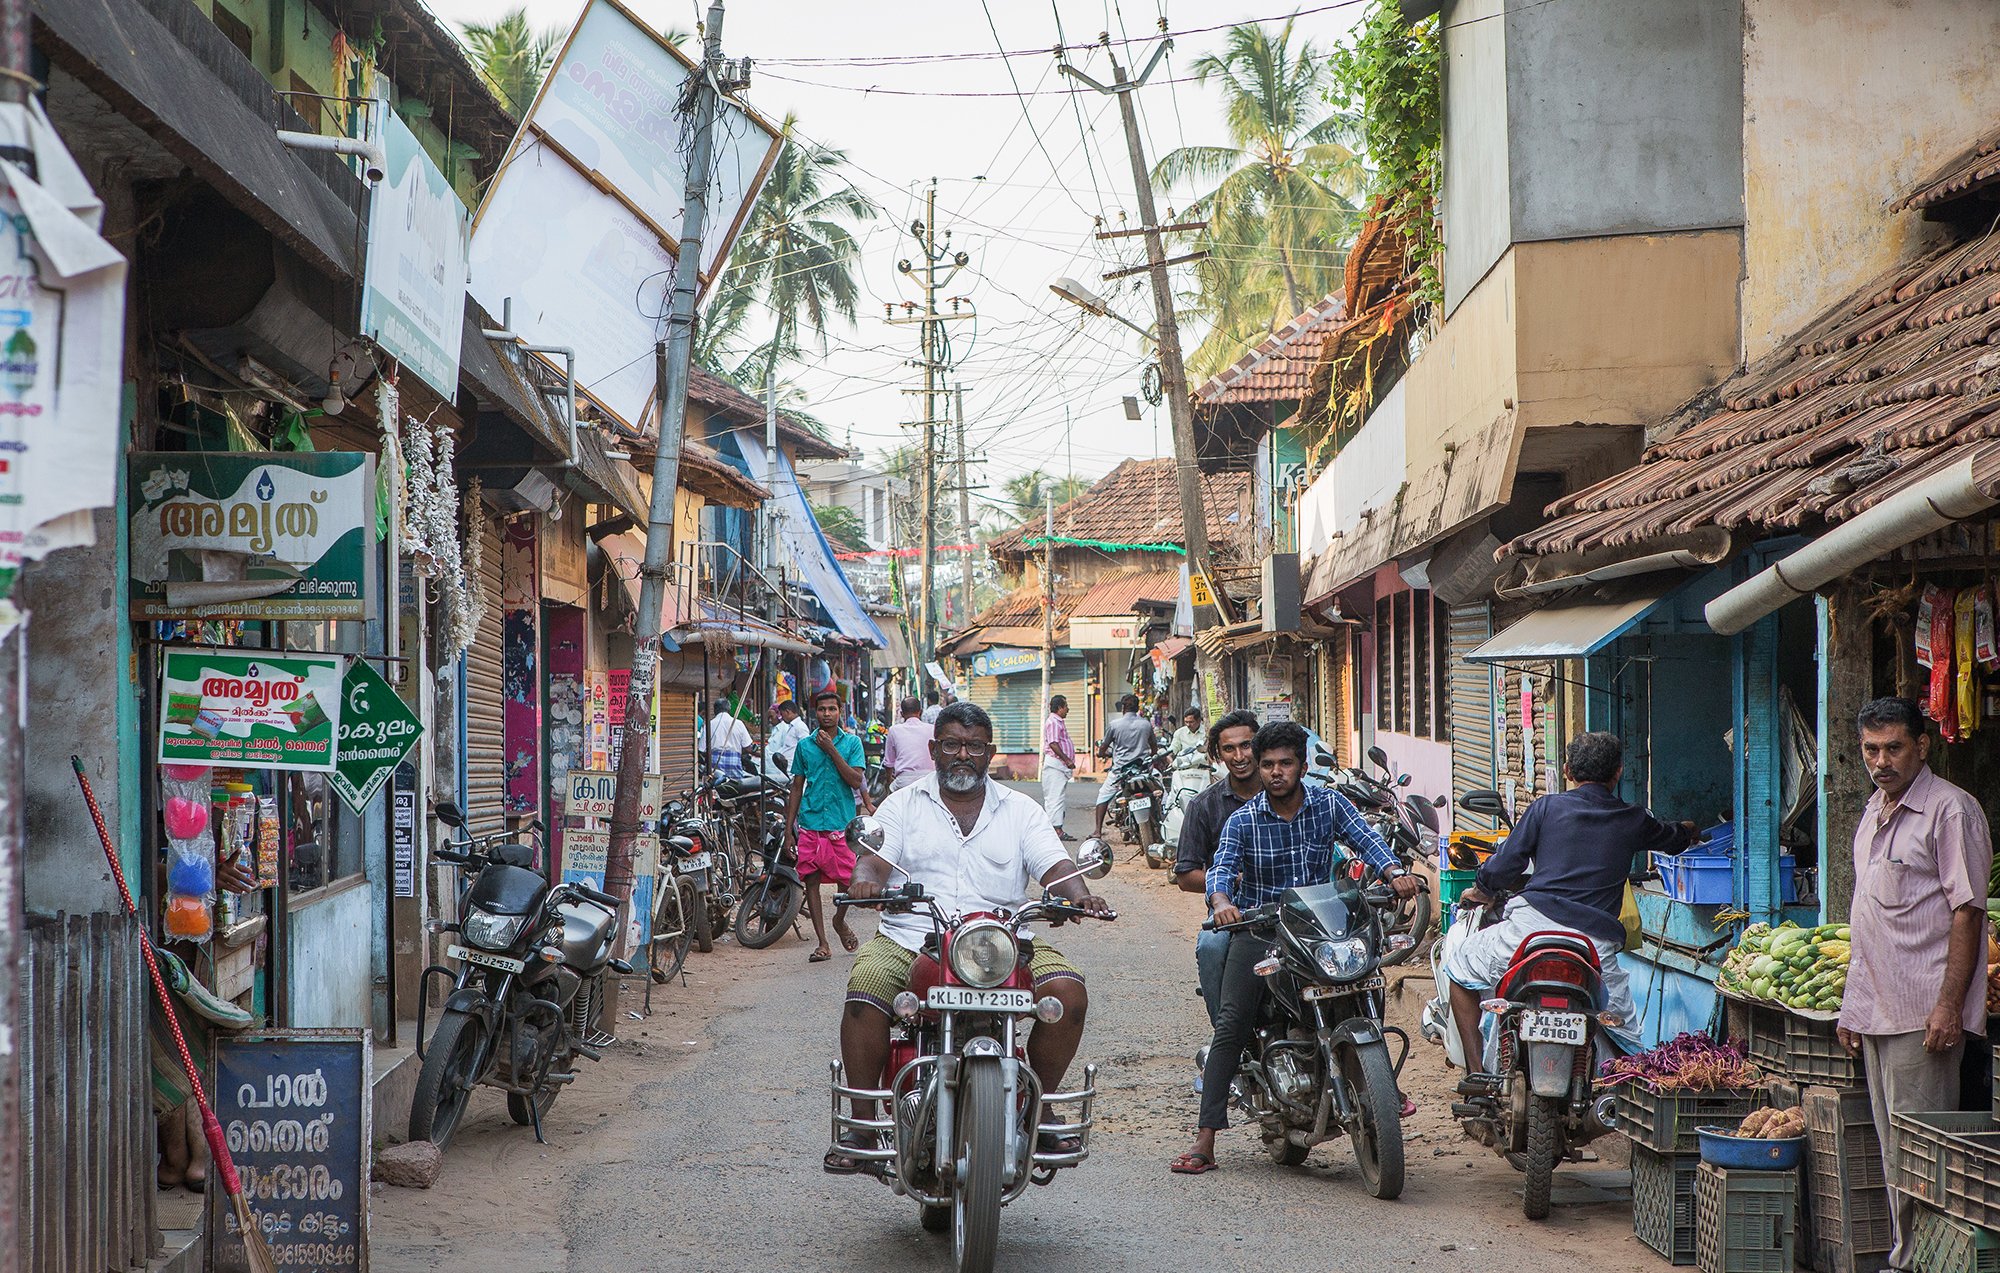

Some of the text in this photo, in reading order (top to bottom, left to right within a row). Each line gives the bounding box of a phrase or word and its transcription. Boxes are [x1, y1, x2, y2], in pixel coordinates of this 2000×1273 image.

[160, 489, 328, 553] അമൃത്
[299, 578, 358, 598] ലഭിക്കുന്നു
[202, 676, 305, 708] അമൃത്
[285, 739, 329, 752] തൈര്
[210, 750, 283, 762] ഇവിടെ ലഭിക്കും
[473, 953, 482, 962] 55
[1536, 1016, 1571, 1028] KL 54
[1529, 1026, 1578, 1040] F 4160
[237, 1068, 328, 1109] പാൽ
[226, 1112, 335, 1153] തൈര്
